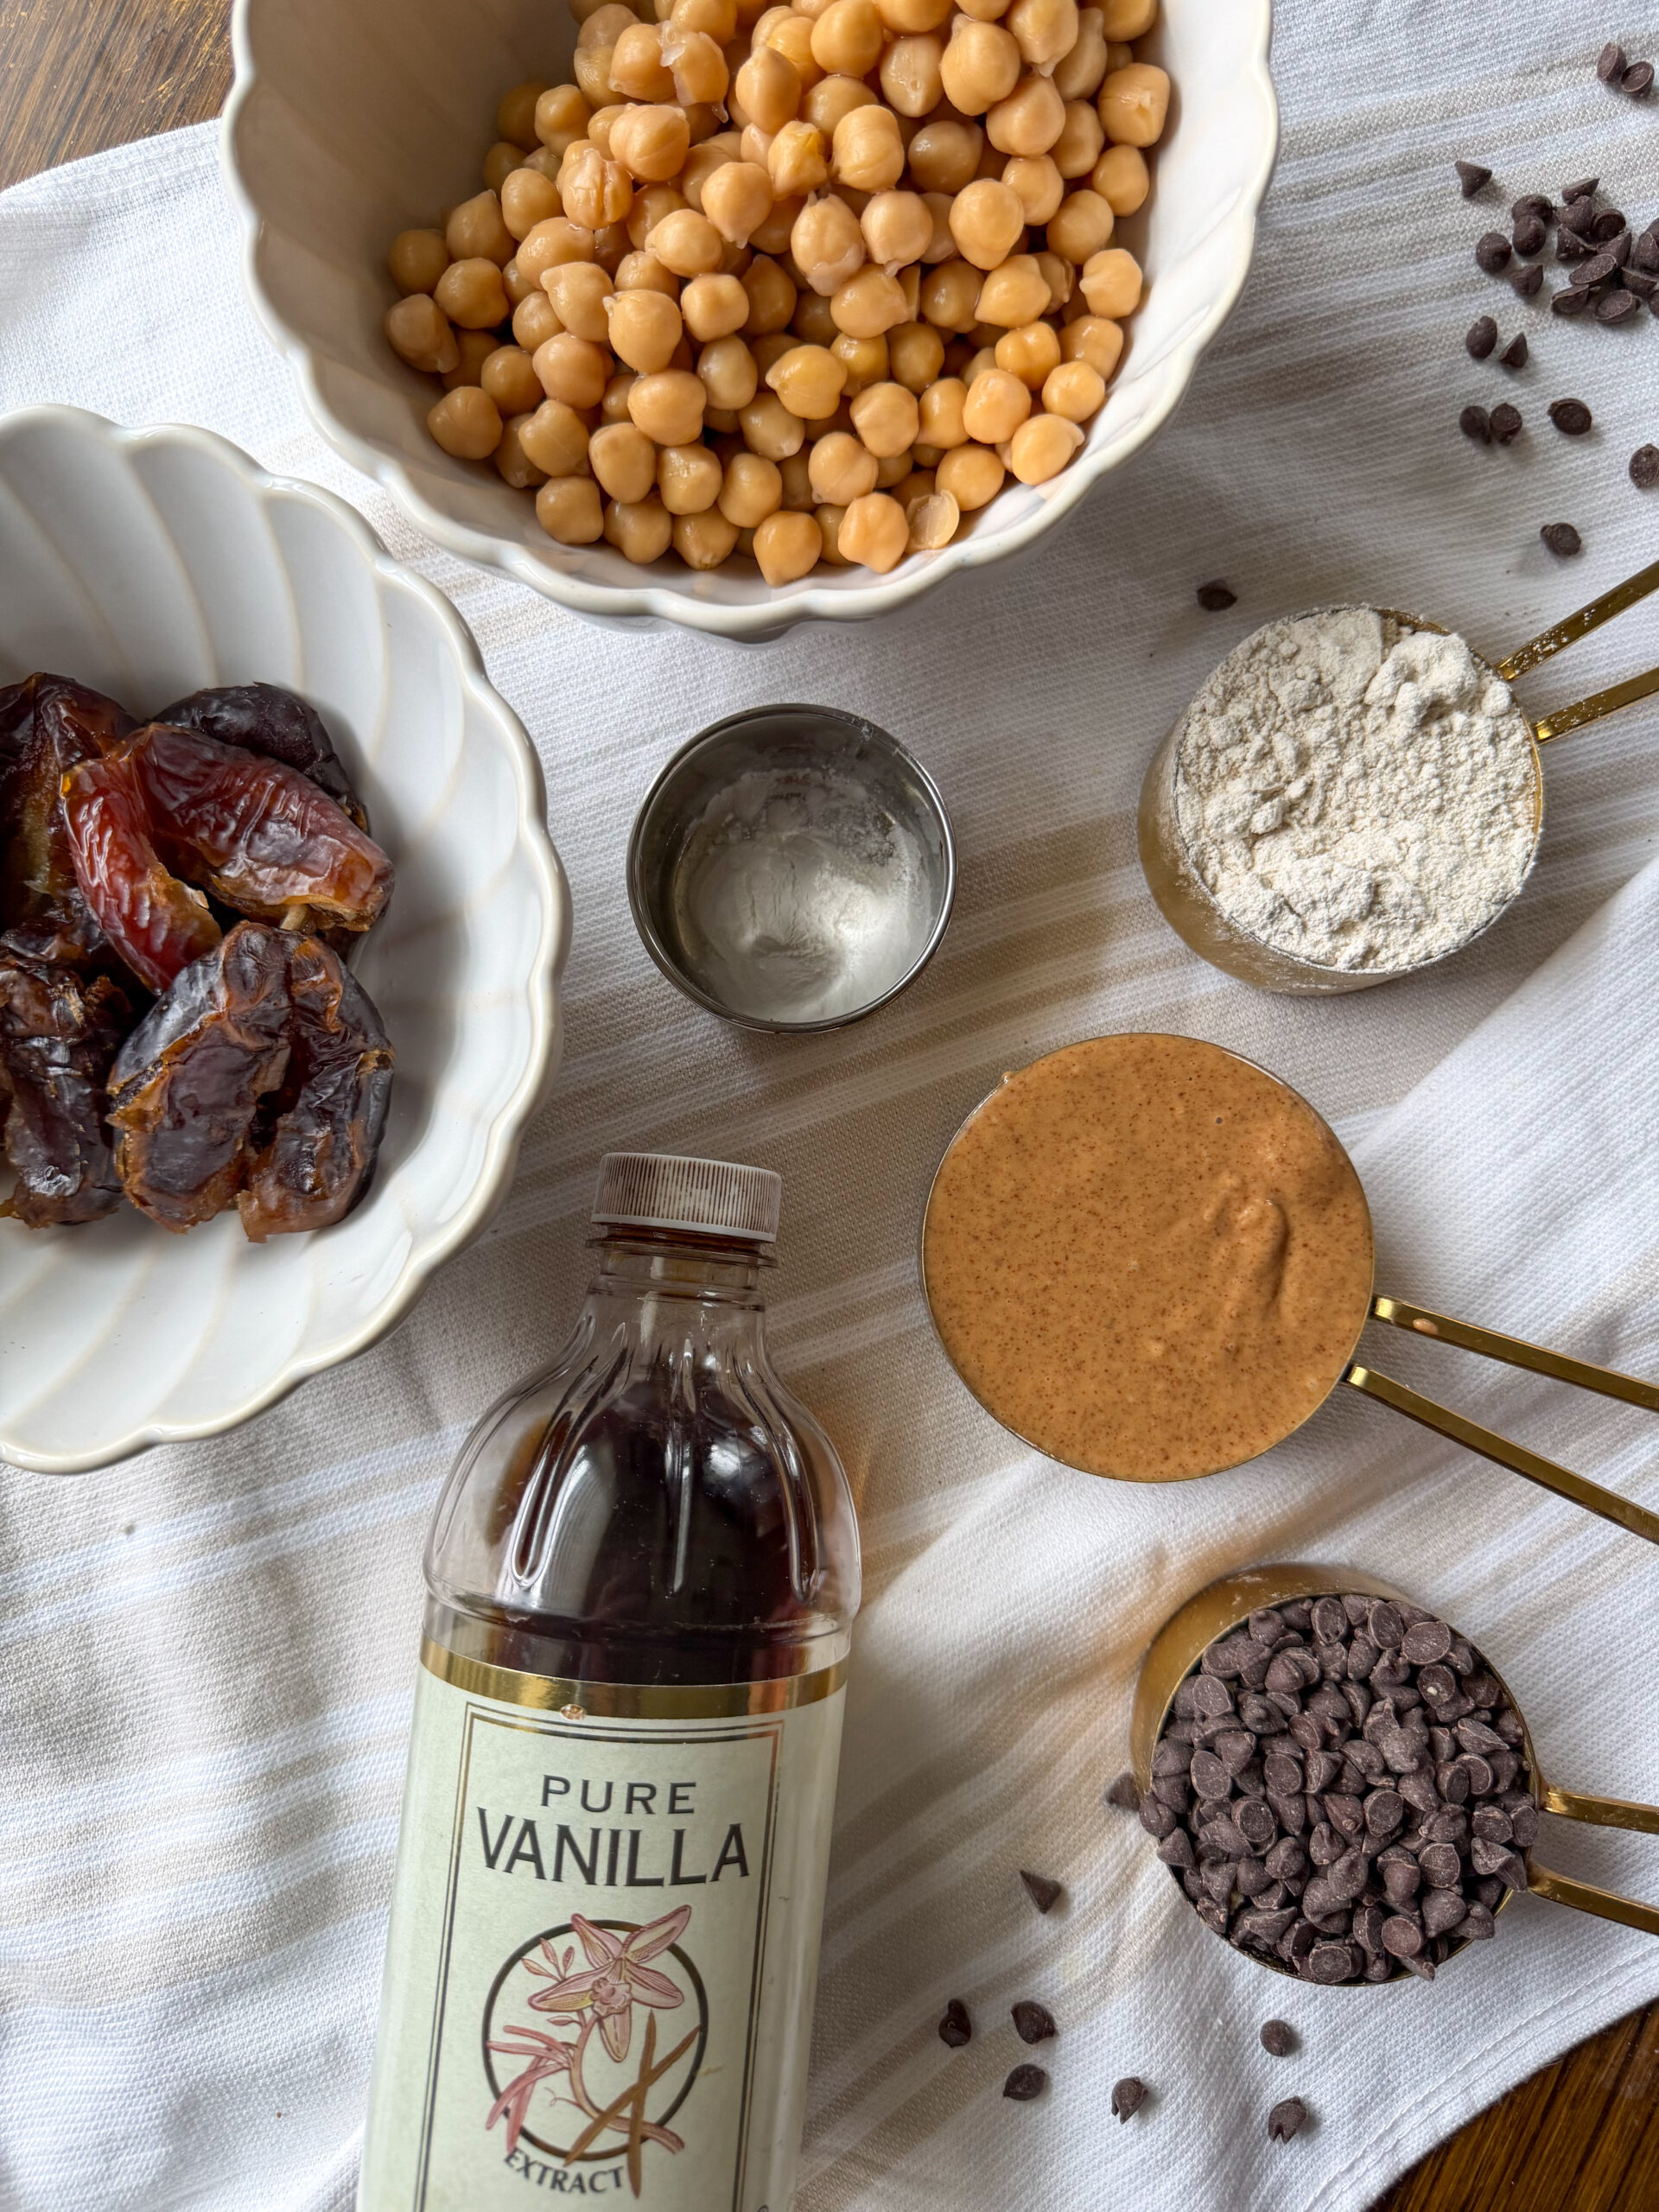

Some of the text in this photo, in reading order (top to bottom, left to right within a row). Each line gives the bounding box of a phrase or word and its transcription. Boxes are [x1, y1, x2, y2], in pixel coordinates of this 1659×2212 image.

[541, 1774, 696, 1815] PURE
[478, 1807, 750, 1887] VANILLA
[504, 2147, 624, 2194] EXTRACT
